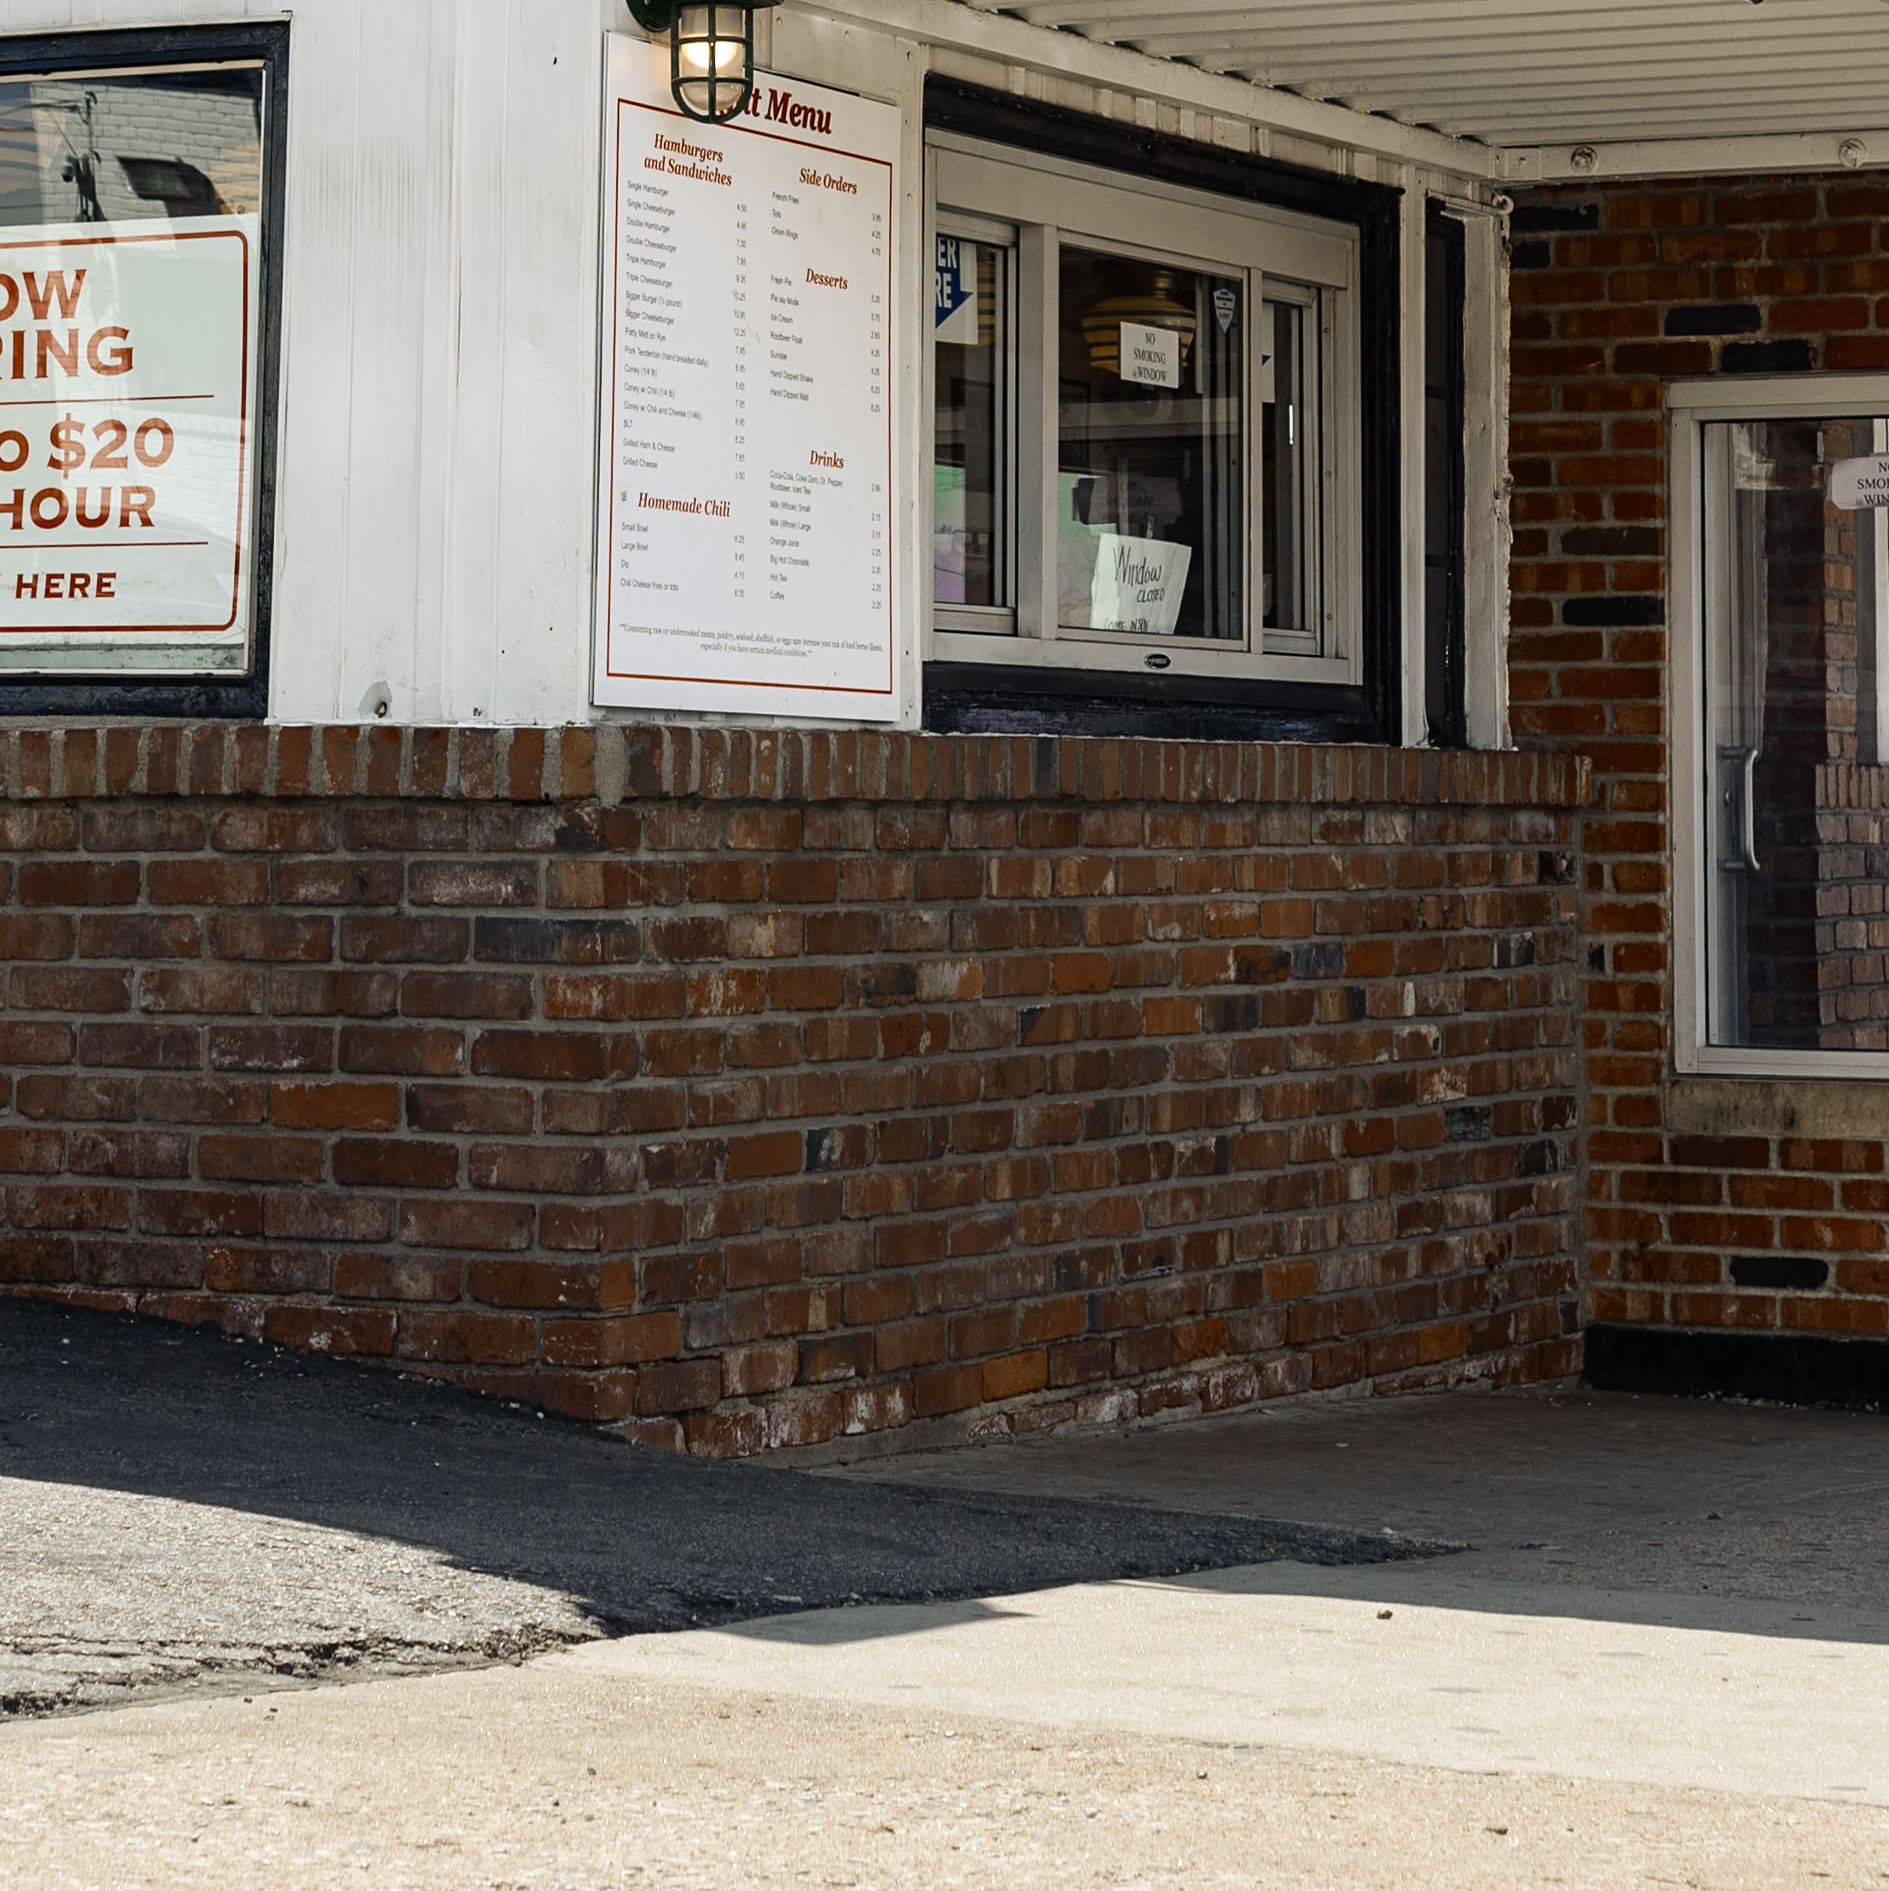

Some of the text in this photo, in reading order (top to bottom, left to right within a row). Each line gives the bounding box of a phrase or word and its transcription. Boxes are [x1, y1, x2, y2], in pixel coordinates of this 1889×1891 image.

[764, 88, 832, 134] Menu
[654, 133, 723, 163] Hamburgers
[644, 152, 731, 186] and Sandwiches
[799, 166, 856, 194] Side Orders
[806, 268, 847, 289] Desserts
[1145, 331, 1156, 345] NO
[1133, 348, 1166, 365] SMOKING
[48, 413, 174, 479] $20
[810, 449, 843, 468] Drinks
[638, 492, 729, 517] Homemade Chili
[1113, 545, 1162, 587] Window
[15, 572, 117, 599] HERE
